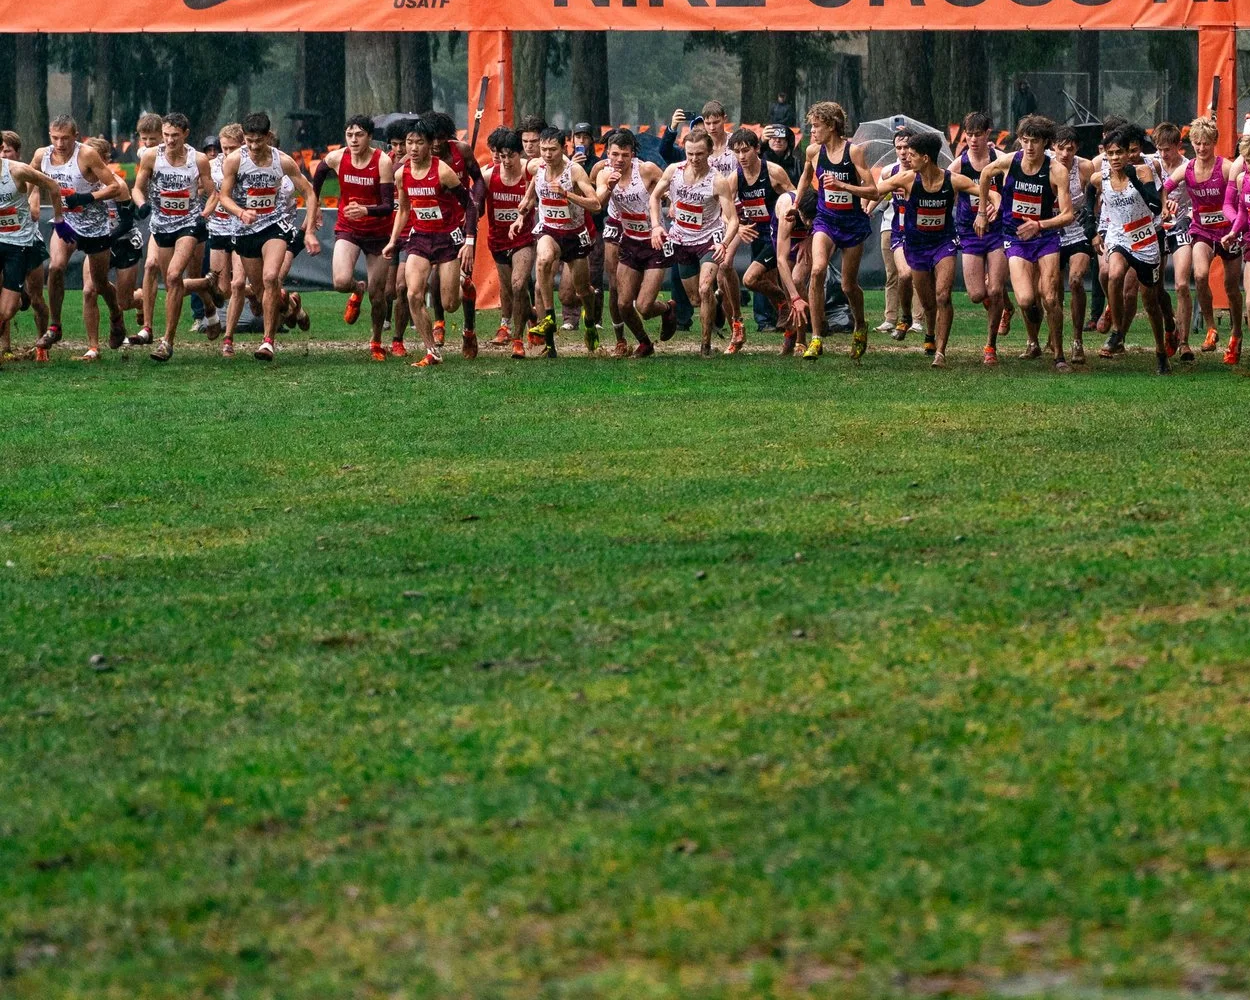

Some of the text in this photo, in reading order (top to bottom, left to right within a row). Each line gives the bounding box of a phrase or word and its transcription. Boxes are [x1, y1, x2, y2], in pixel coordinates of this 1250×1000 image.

[343, 174, 375, 186] MANHATTAN
[407, 187, 436, 196] MANHATTAN
[1015, 181, 1044, 194] LINCROFT
[828, 194, 848, 203] 275
[919, 199, 947, 207] LINCROFT
[164, 201, 185, 209] 336
[251, 199, 271, 208] 340
[547, 210, 566, 218] 373
[1017, 205, 1037, 214] 272
[418, 211, 438, 220] 264
[498, 212, 518, 220] 263
[680, 213, 697, 223] 374
[1205, 214, 1224, 223] 225
[921, 218, 941, 226] 276
[1131, 227, 1153, 243] 304
